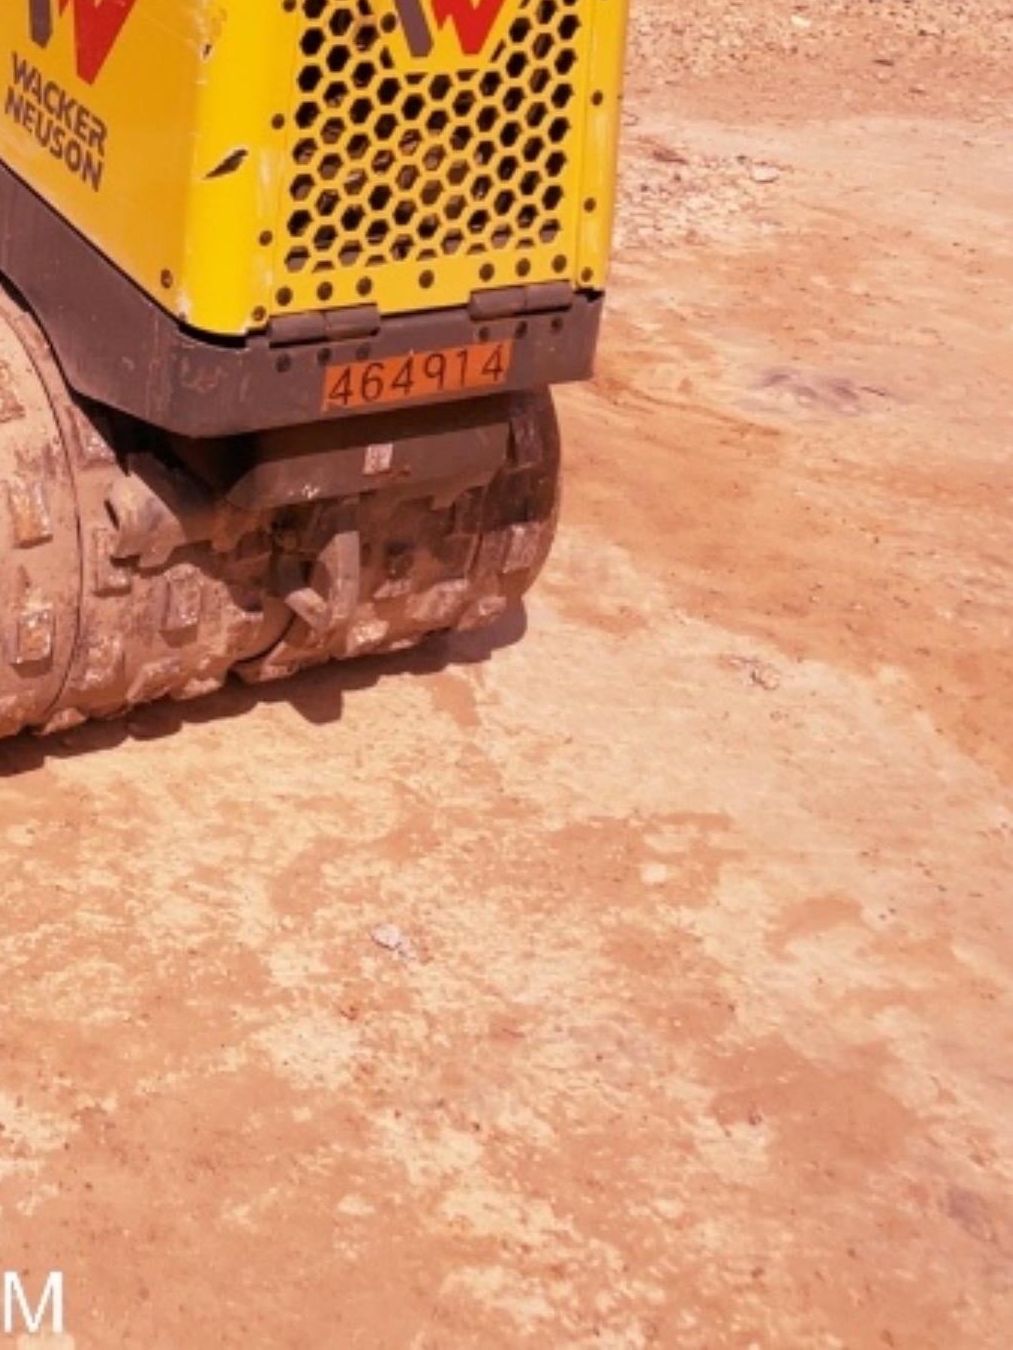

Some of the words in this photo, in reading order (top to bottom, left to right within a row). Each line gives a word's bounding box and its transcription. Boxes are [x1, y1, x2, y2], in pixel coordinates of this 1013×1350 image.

[4, 86, 104, 193] NEUSON
[11, 51, 108, 157] WACKER
[327, 345, 505, 406] 464914
